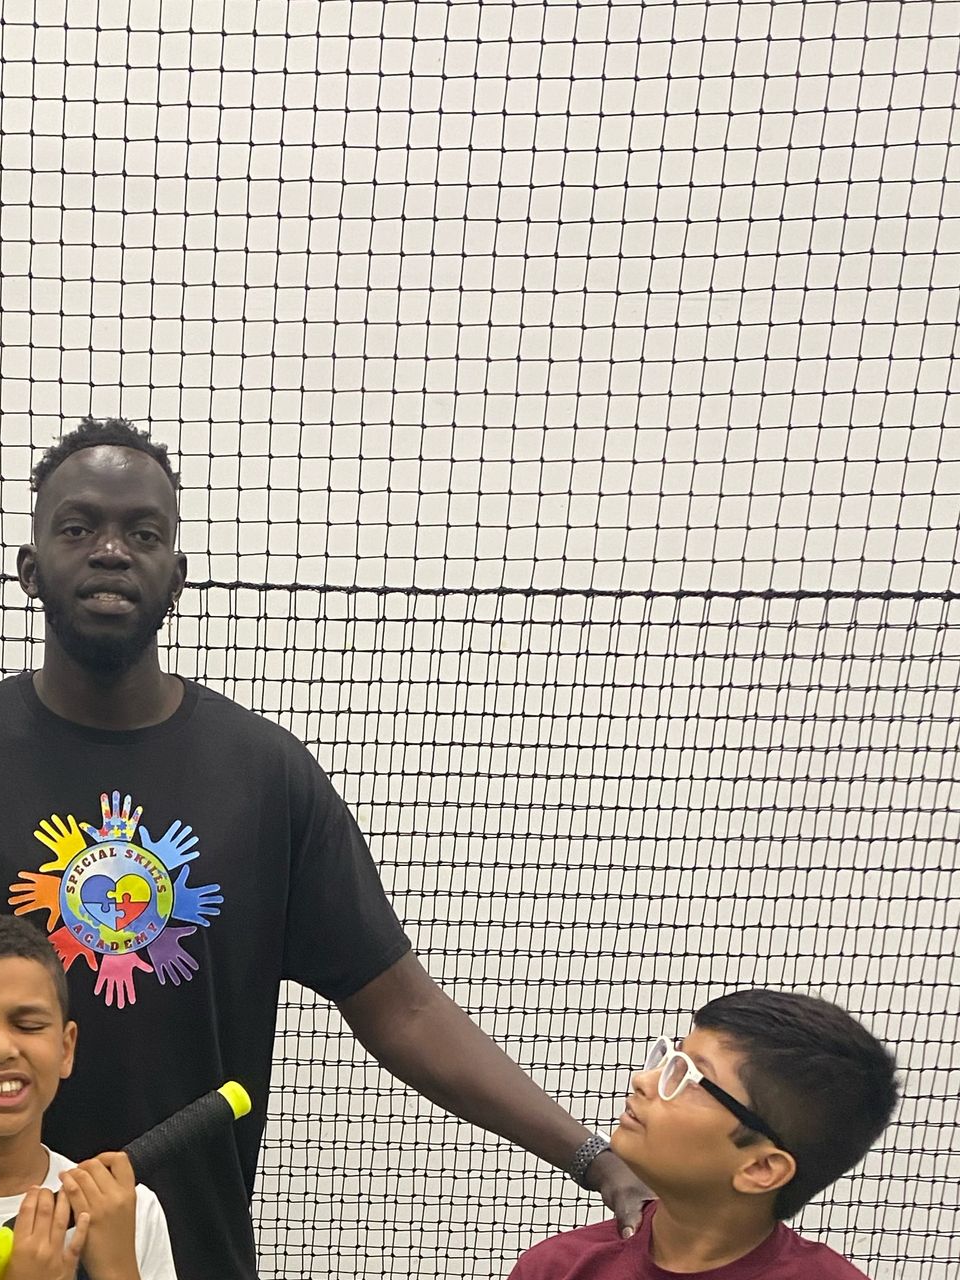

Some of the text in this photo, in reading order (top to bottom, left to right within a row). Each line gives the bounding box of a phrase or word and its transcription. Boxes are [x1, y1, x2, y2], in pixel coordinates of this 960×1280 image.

[66, 847, 167, 894] SPECIAL SKILLS
[73, 922, 159, 951] ACADEMY
